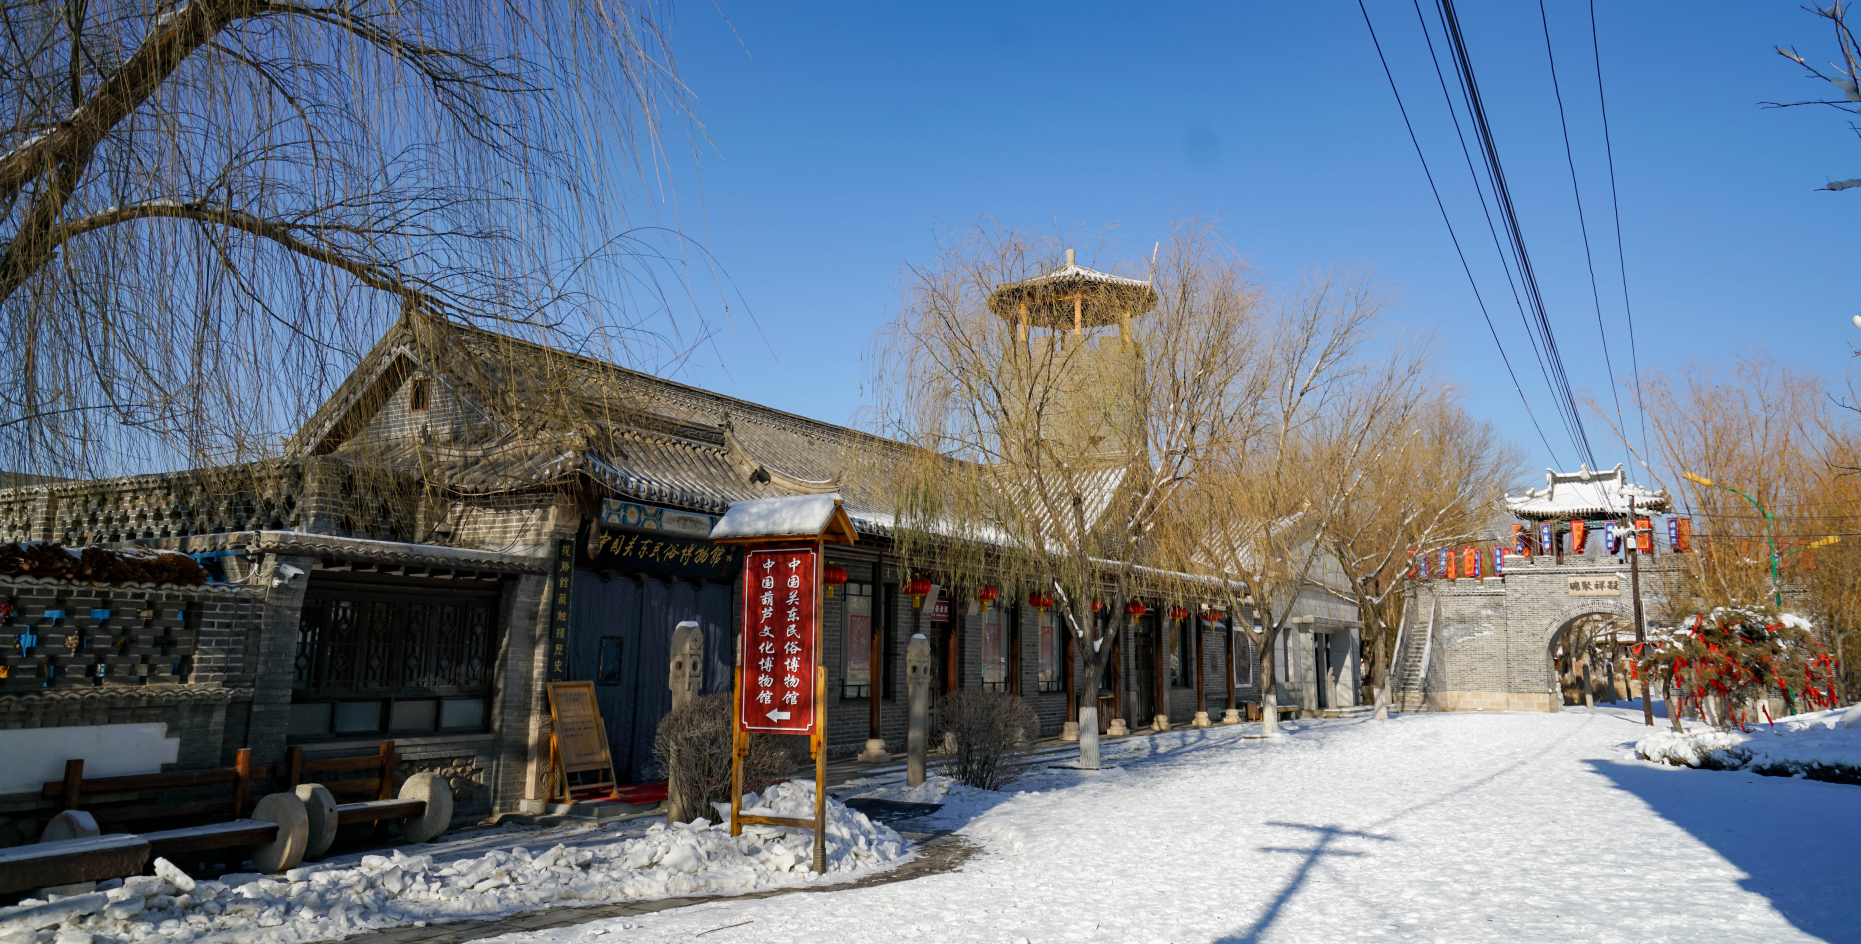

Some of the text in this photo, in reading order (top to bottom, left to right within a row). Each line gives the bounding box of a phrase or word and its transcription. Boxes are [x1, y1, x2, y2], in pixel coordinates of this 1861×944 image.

[756, 558, 775, 705] 中国葫芦文化博物馆
[782, 557, 802, 706] 中国关东民俗博物馆
